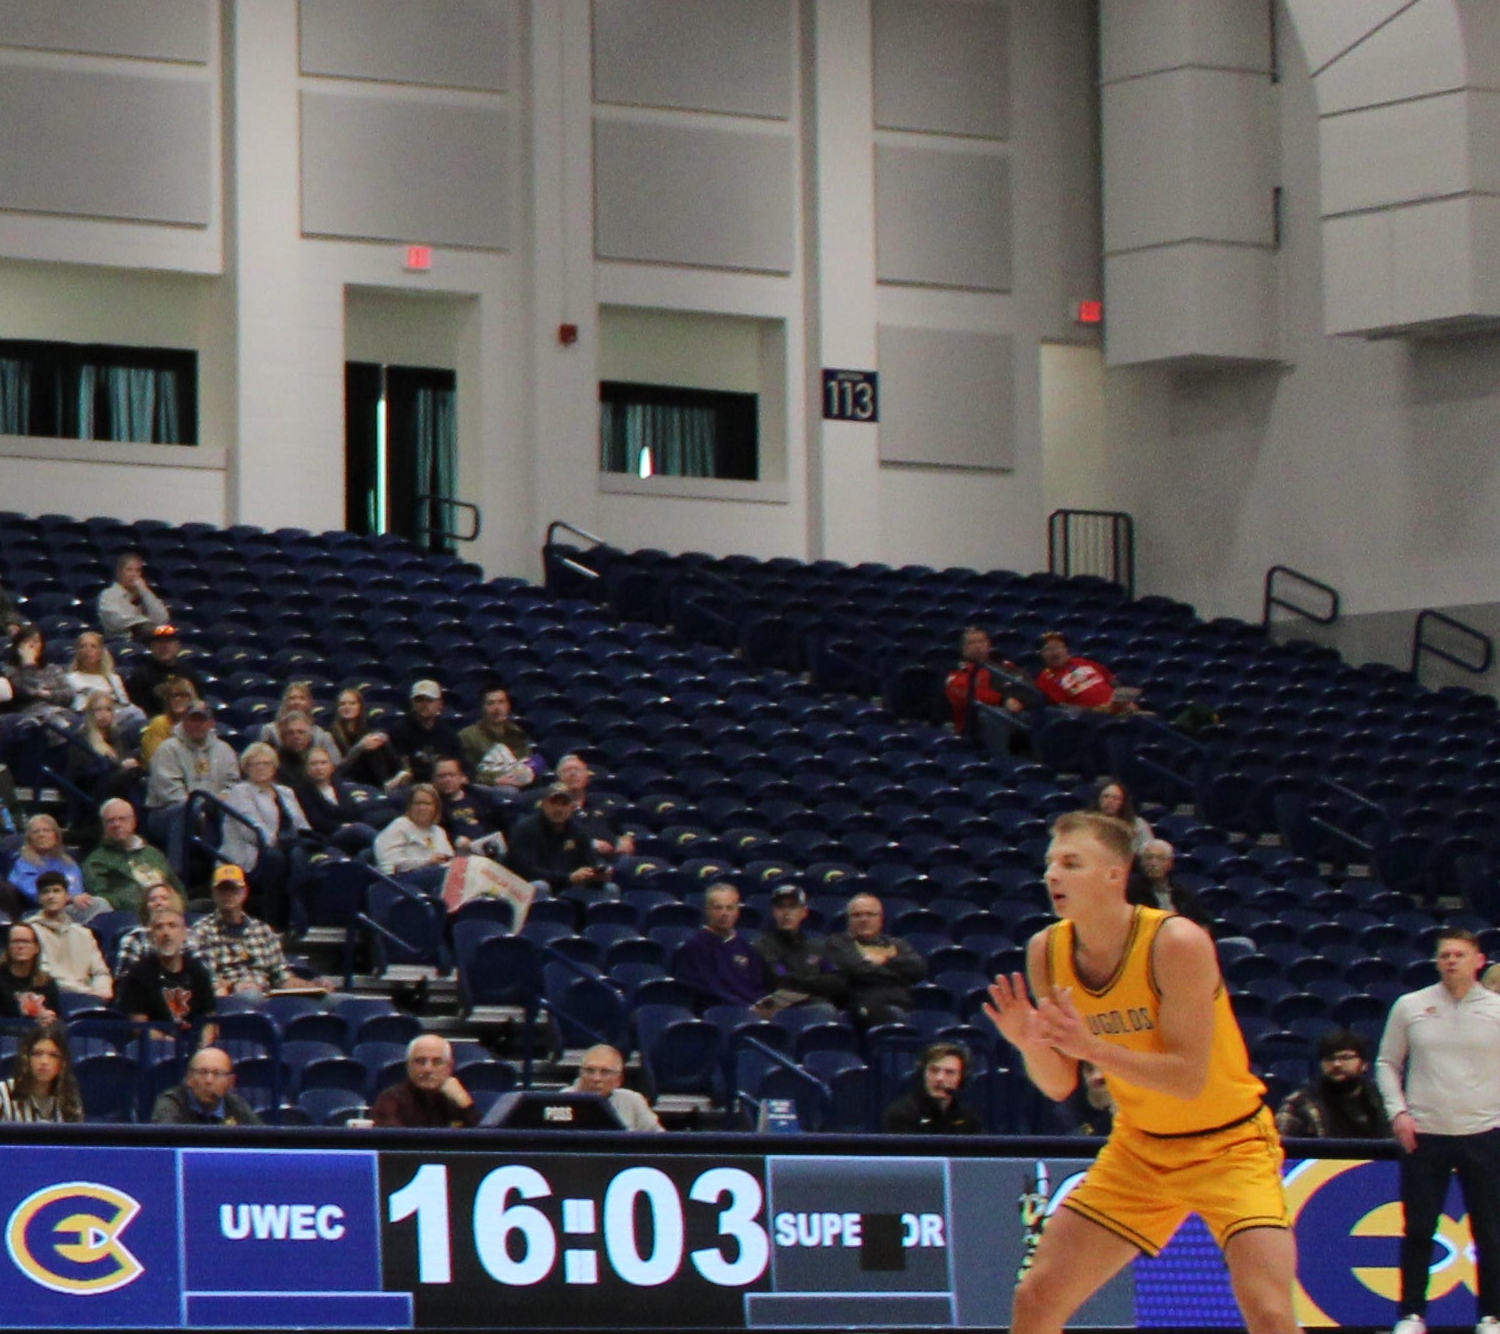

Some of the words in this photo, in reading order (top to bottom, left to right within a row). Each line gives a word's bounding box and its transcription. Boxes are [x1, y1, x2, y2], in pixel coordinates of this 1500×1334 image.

[829, 379, 874, 419] 113
[218, 1202, 347, 1241] UWEC
[389, 1163, 771, 1286] 16:03
[774, 1211, 944, 1247] SUPEOR
